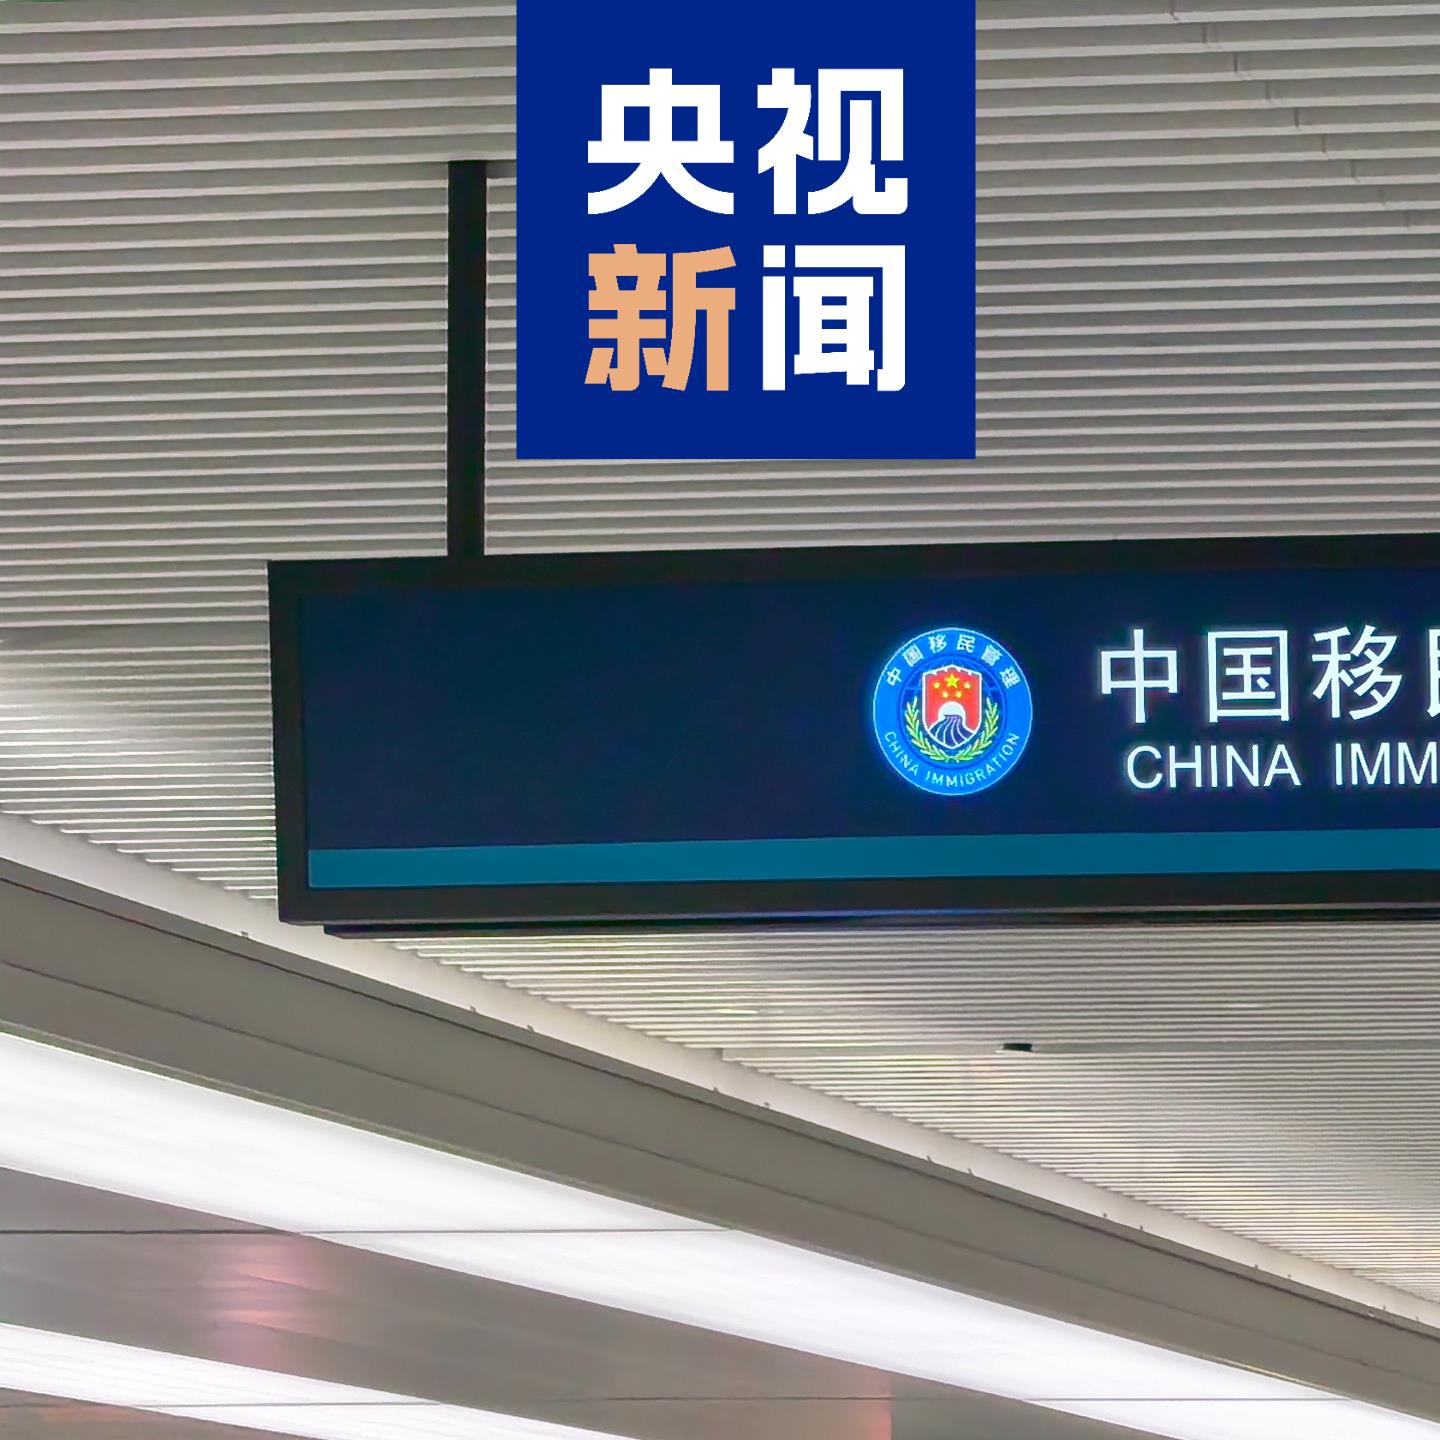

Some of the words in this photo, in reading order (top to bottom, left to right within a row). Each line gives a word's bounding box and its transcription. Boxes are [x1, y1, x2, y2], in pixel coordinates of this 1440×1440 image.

[885, 732, 919, 776] CHINA
[926, 732, 1020, 787] IMMIGRATION
[1126, 742, 1301, 790] CHINA
